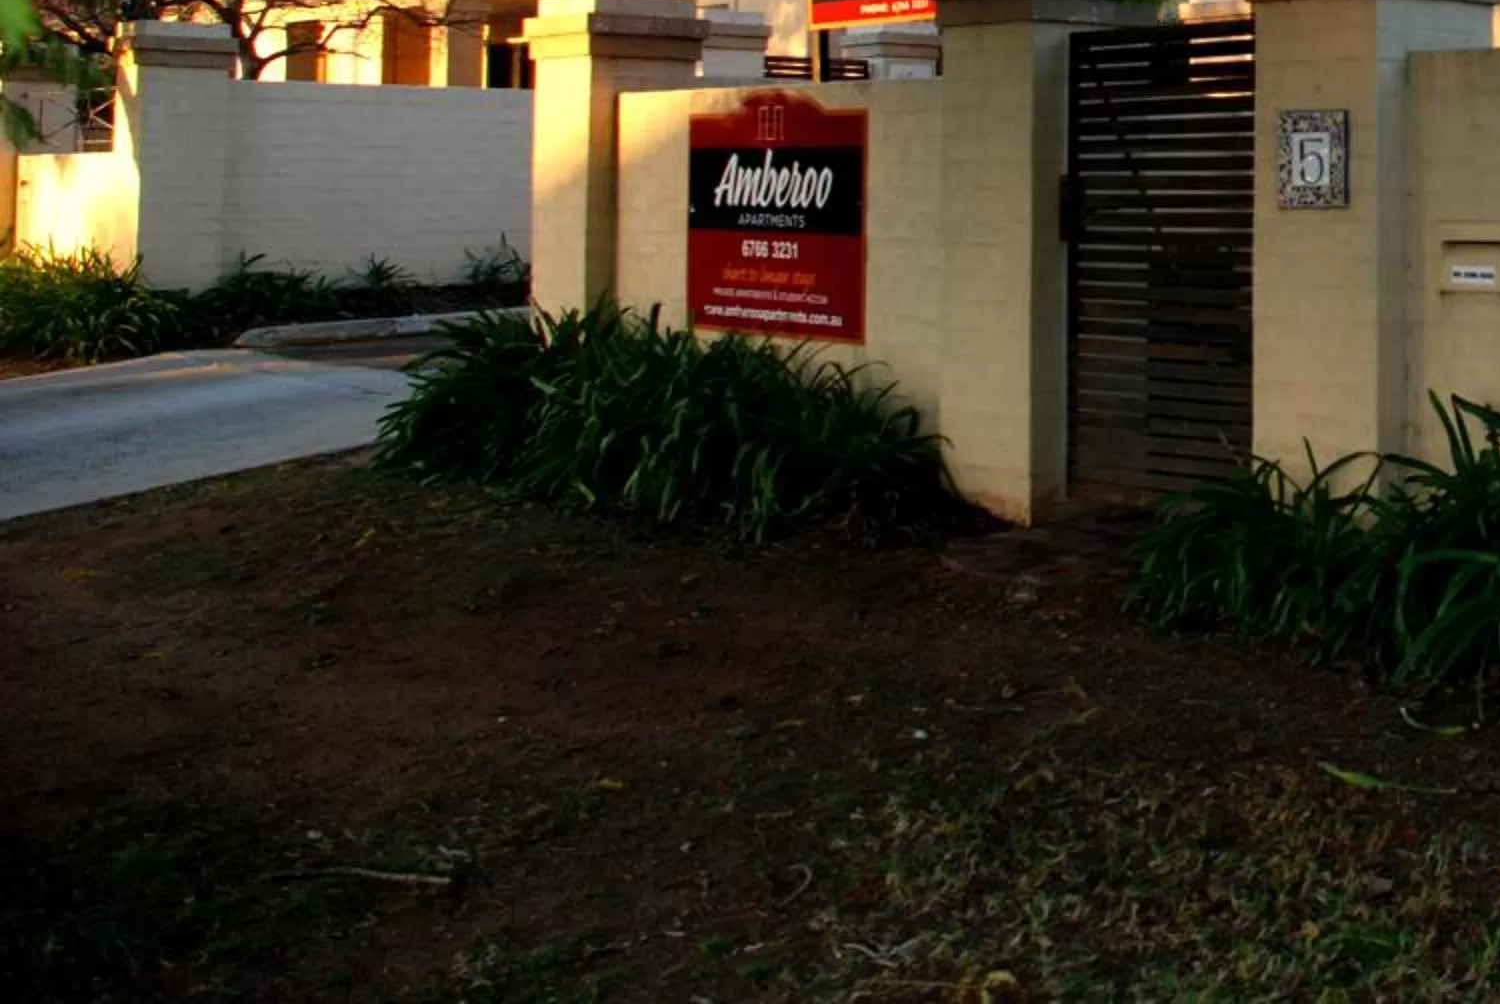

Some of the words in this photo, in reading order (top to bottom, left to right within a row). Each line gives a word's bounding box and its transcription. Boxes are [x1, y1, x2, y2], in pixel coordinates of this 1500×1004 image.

[714, 148, 832, 209] Amberoo
[1299, 137, 1325, 184] 5
[737, 213, 806, 229] APARTMENTS
